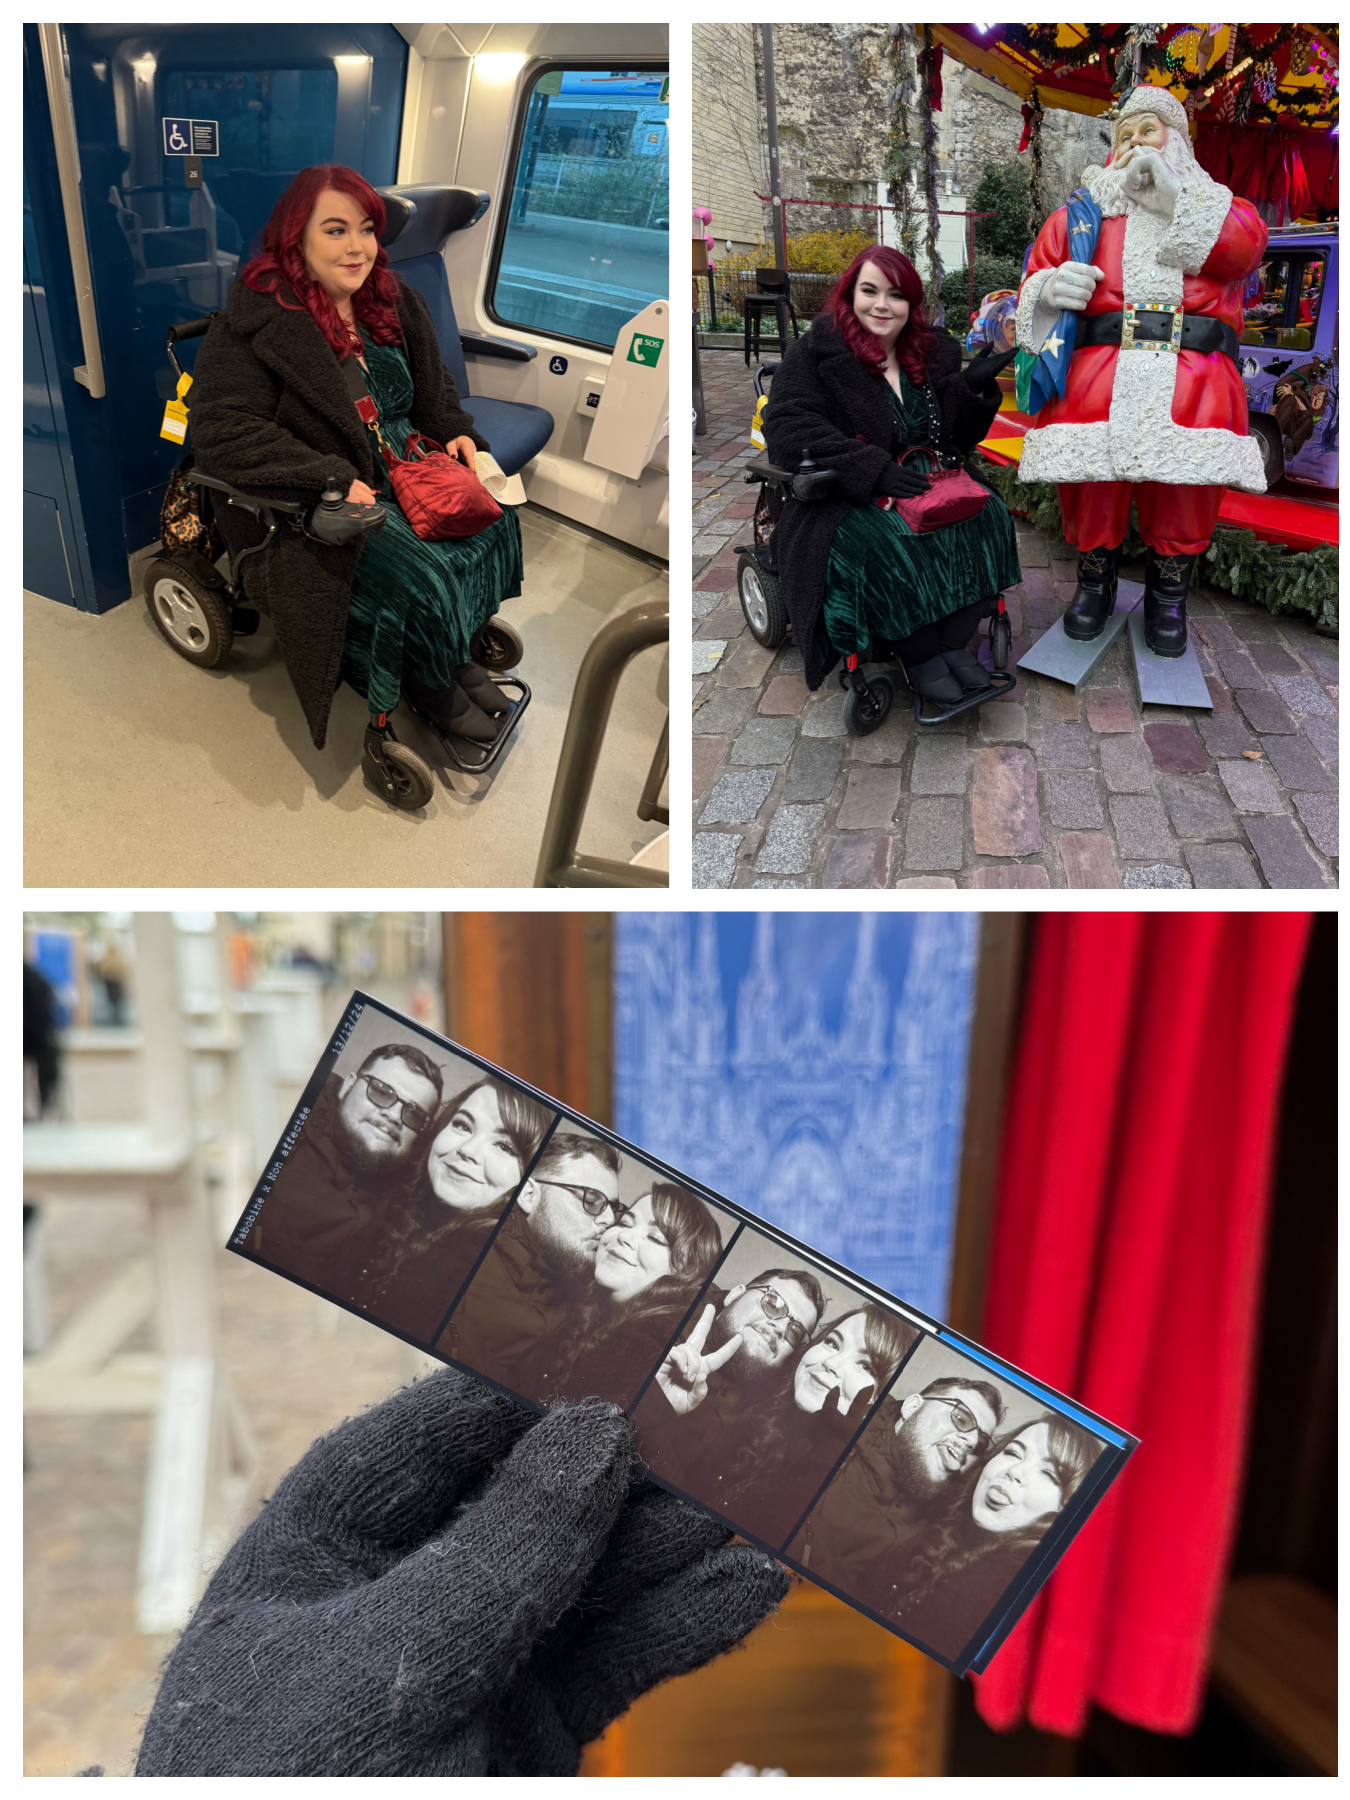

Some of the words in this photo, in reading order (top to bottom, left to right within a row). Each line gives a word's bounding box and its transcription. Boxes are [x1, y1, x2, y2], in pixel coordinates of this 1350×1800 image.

[643, 338, 661, 349] SOS
[332, 1003, 364, 1055] 13/12/24
[234, 1197, 265, 1245] Tabobine
[266, 1161, 284, 1181] Non
[281, 1106, 311, 1157] affectée
